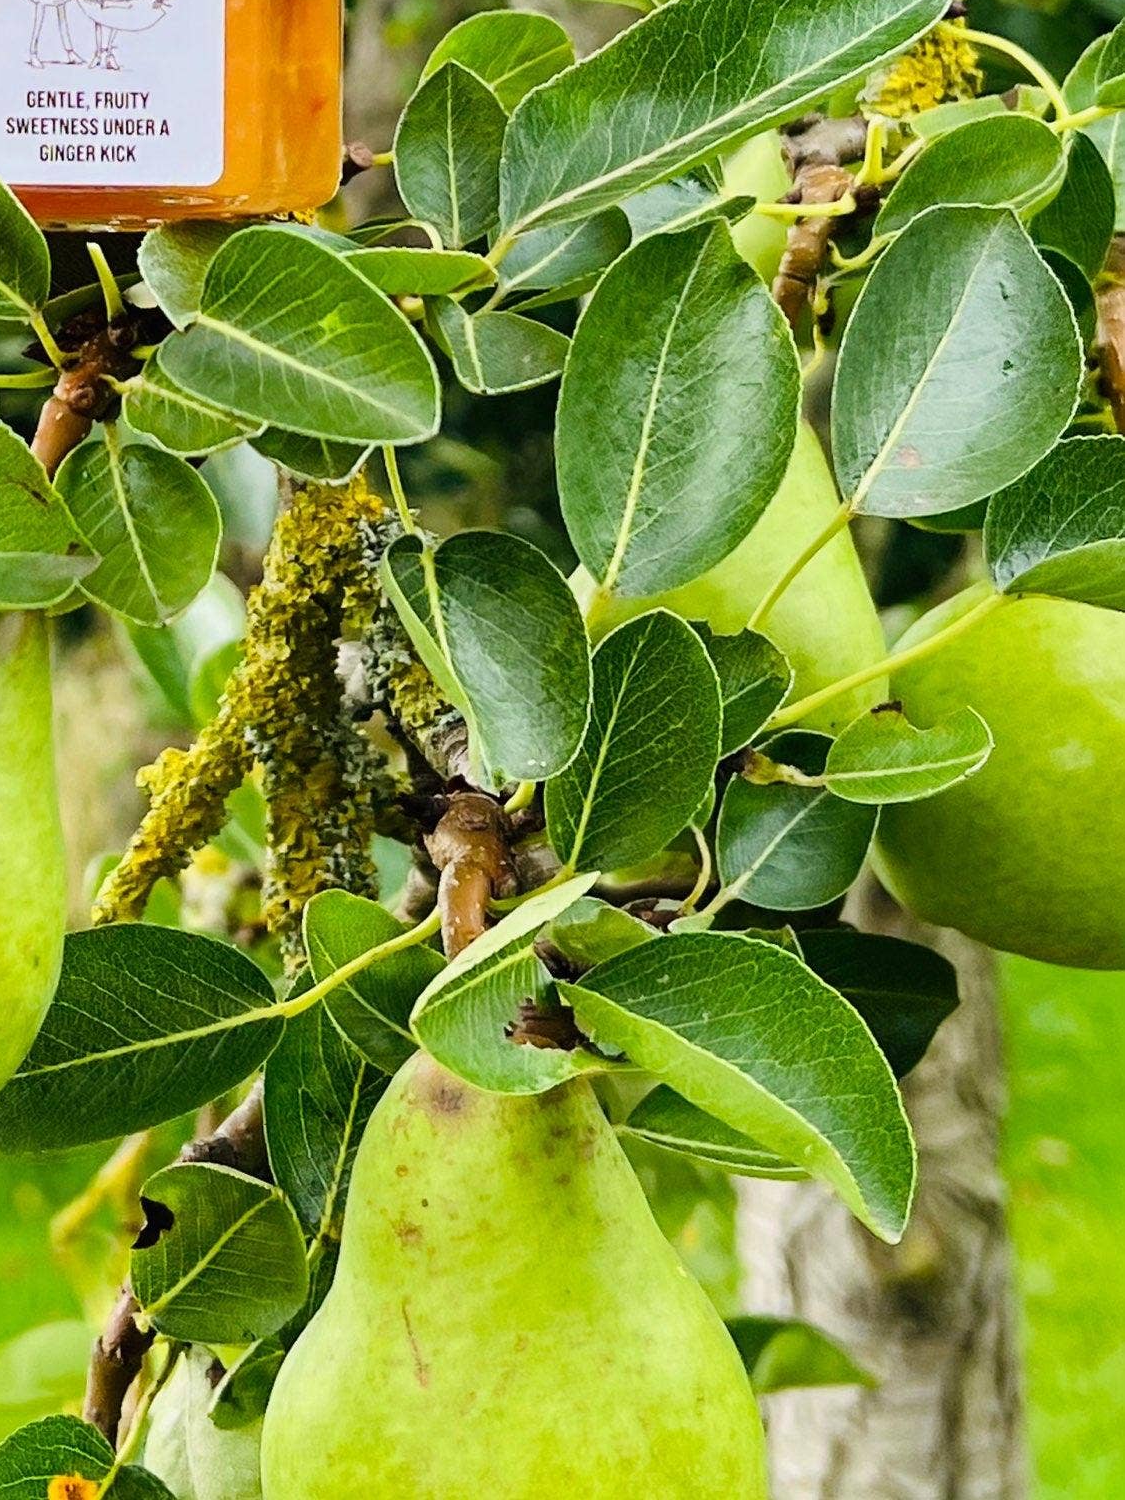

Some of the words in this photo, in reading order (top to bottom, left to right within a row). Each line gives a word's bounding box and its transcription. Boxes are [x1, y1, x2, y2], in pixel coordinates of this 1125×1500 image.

[26, 90, 91, 112] GENTLE,
[94, 91, 150, 110] FRUITY
[6, 117, 99, 136] SWEETNESS
[103, 118, 155, 137] UNDER
[159, 119, 170, 137] A
[39, 144, 95, 163] GINGER
[100, 145, 137, 163] KICK
